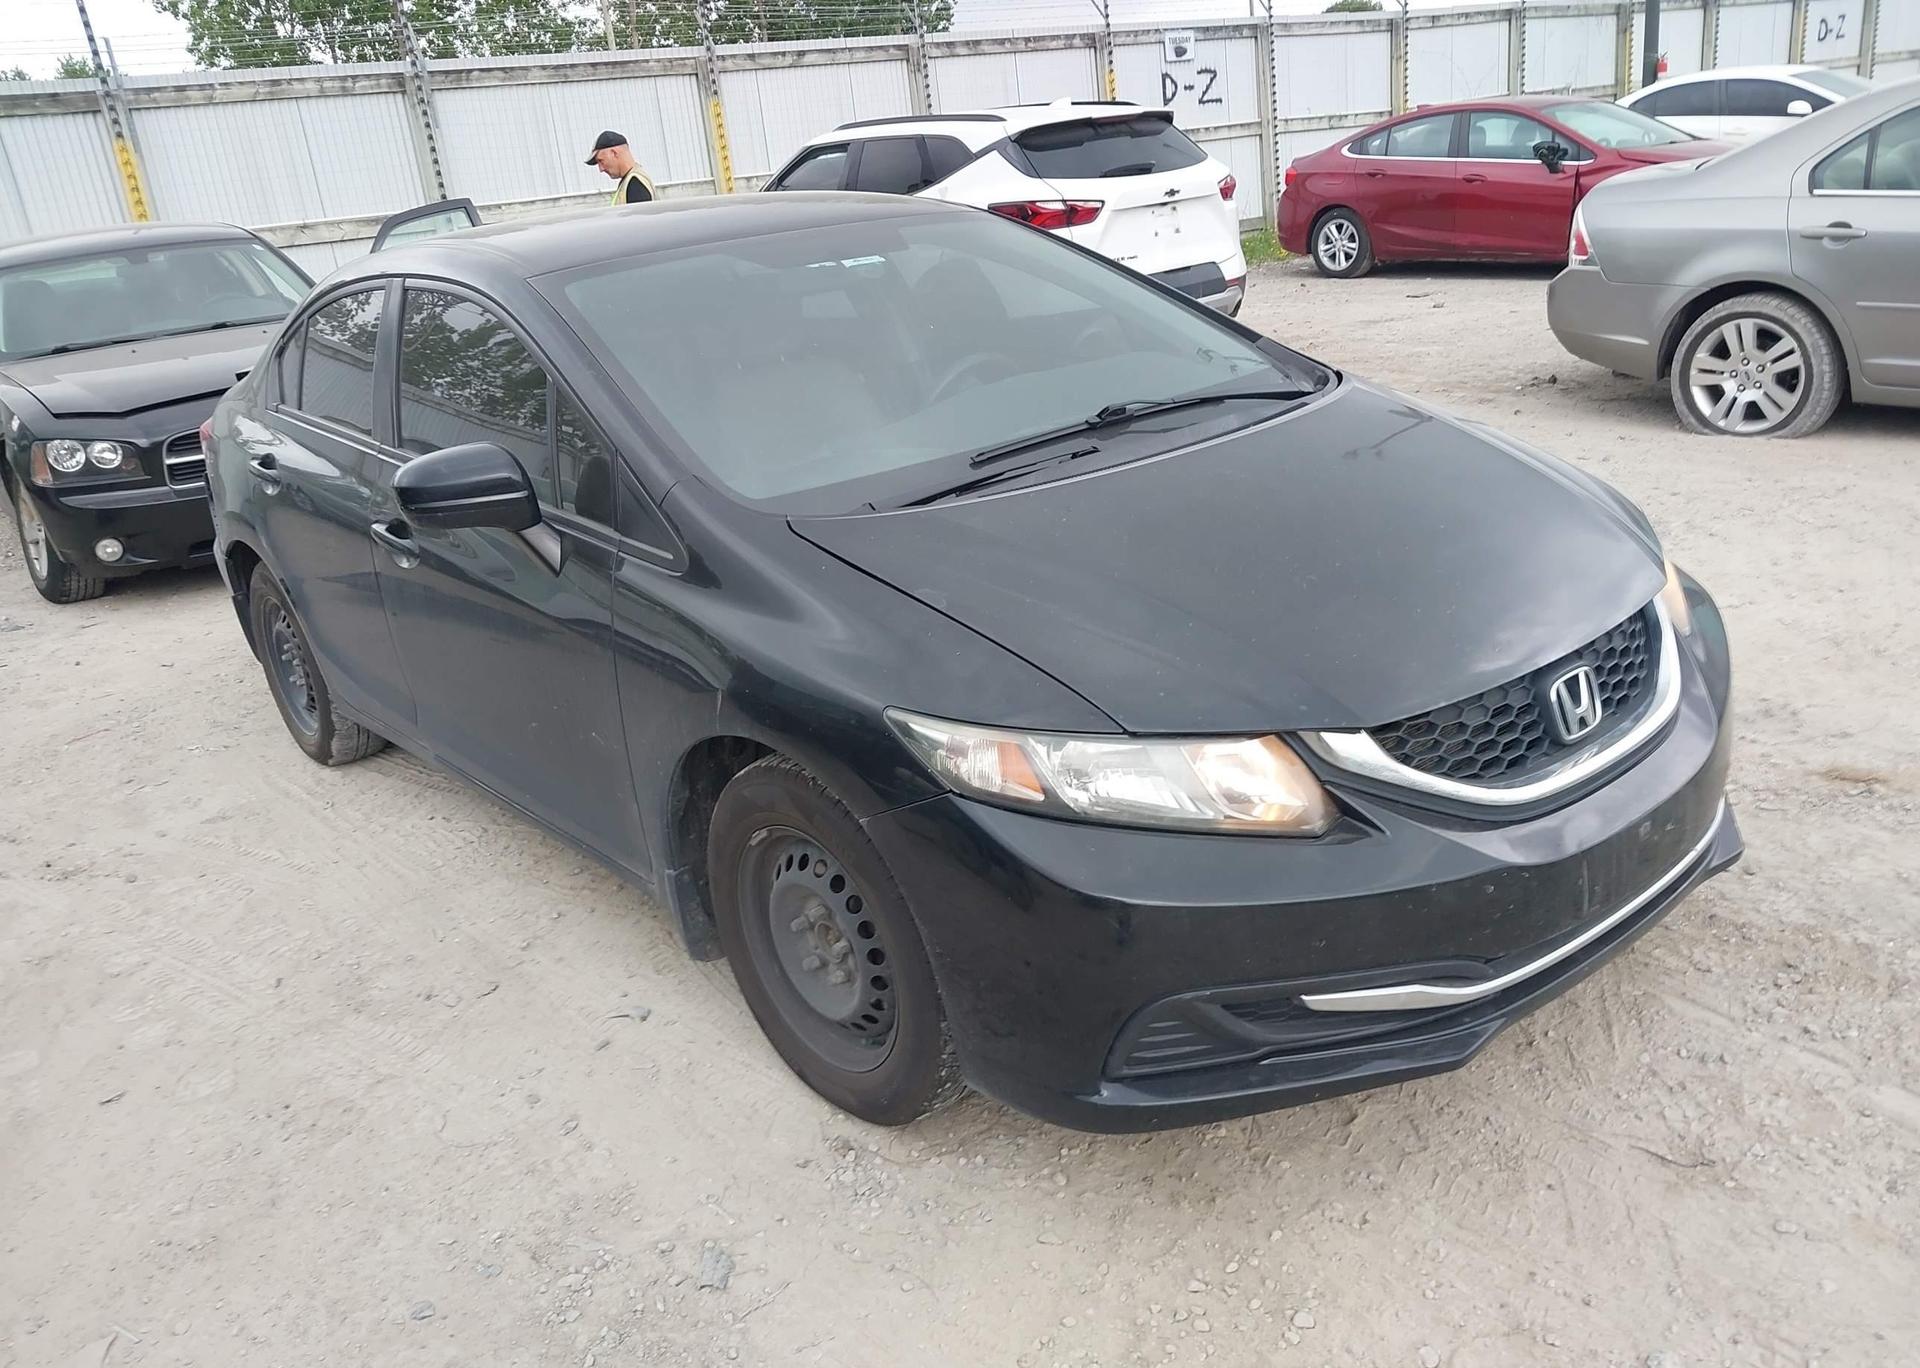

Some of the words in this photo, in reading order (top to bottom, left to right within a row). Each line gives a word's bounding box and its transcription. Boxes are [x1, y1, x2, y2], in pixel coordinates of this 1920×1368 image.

[1168, 36, 1192, 45] TUESDAY
[1817, 14, 1846, 42] D-Z
[1161, 66, 1223, 107] D-Z
